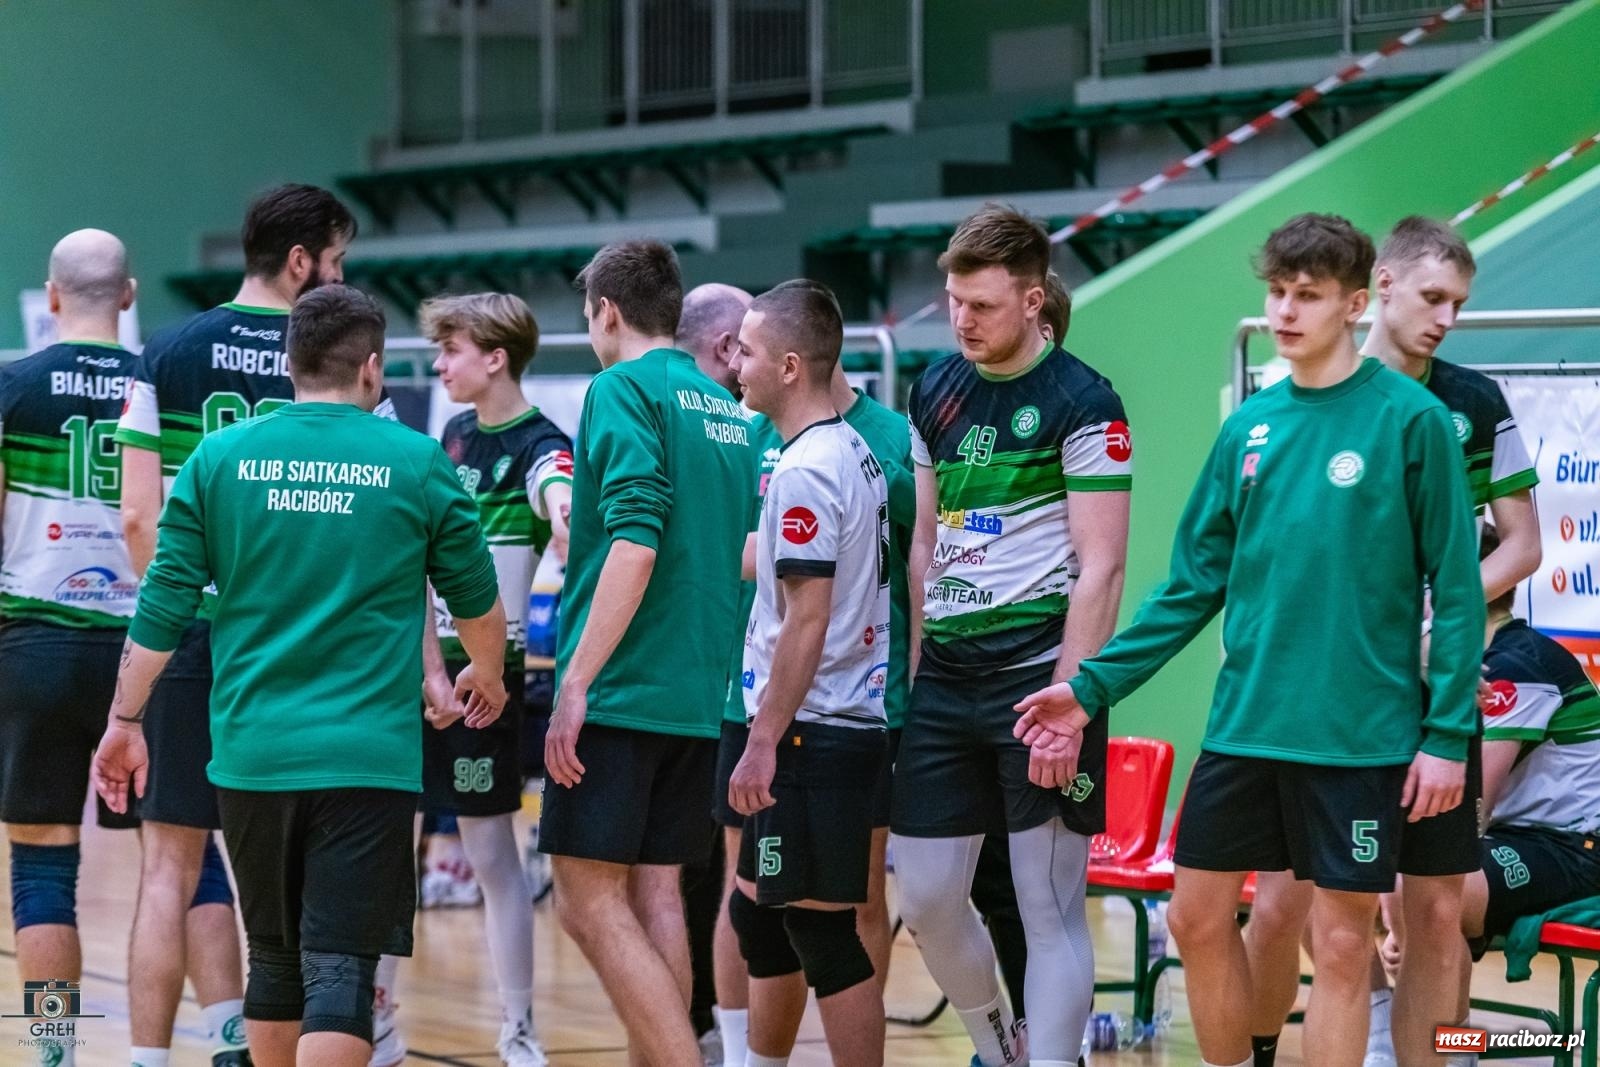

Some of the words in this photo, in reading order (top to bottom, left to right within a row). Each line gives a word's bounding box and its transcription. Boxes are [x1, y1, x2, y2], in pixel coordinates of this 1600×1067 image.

[957, 424, 997, 467] 49
[237, 459, 284, 481] KLUB
[287, 460, 391, 488] SIATKARSKI
[1556, 451, 1600, 484] Biur
[267, 487, 355, 514] RACIBÓRZ
[781, 518, 819, 534] RV
[1572, 563, 1600, 595] ul.
[453, 757, 494, 792] 98
[757, 836, 782, 877] 15
[1352, 820, 1379, 863] 5
